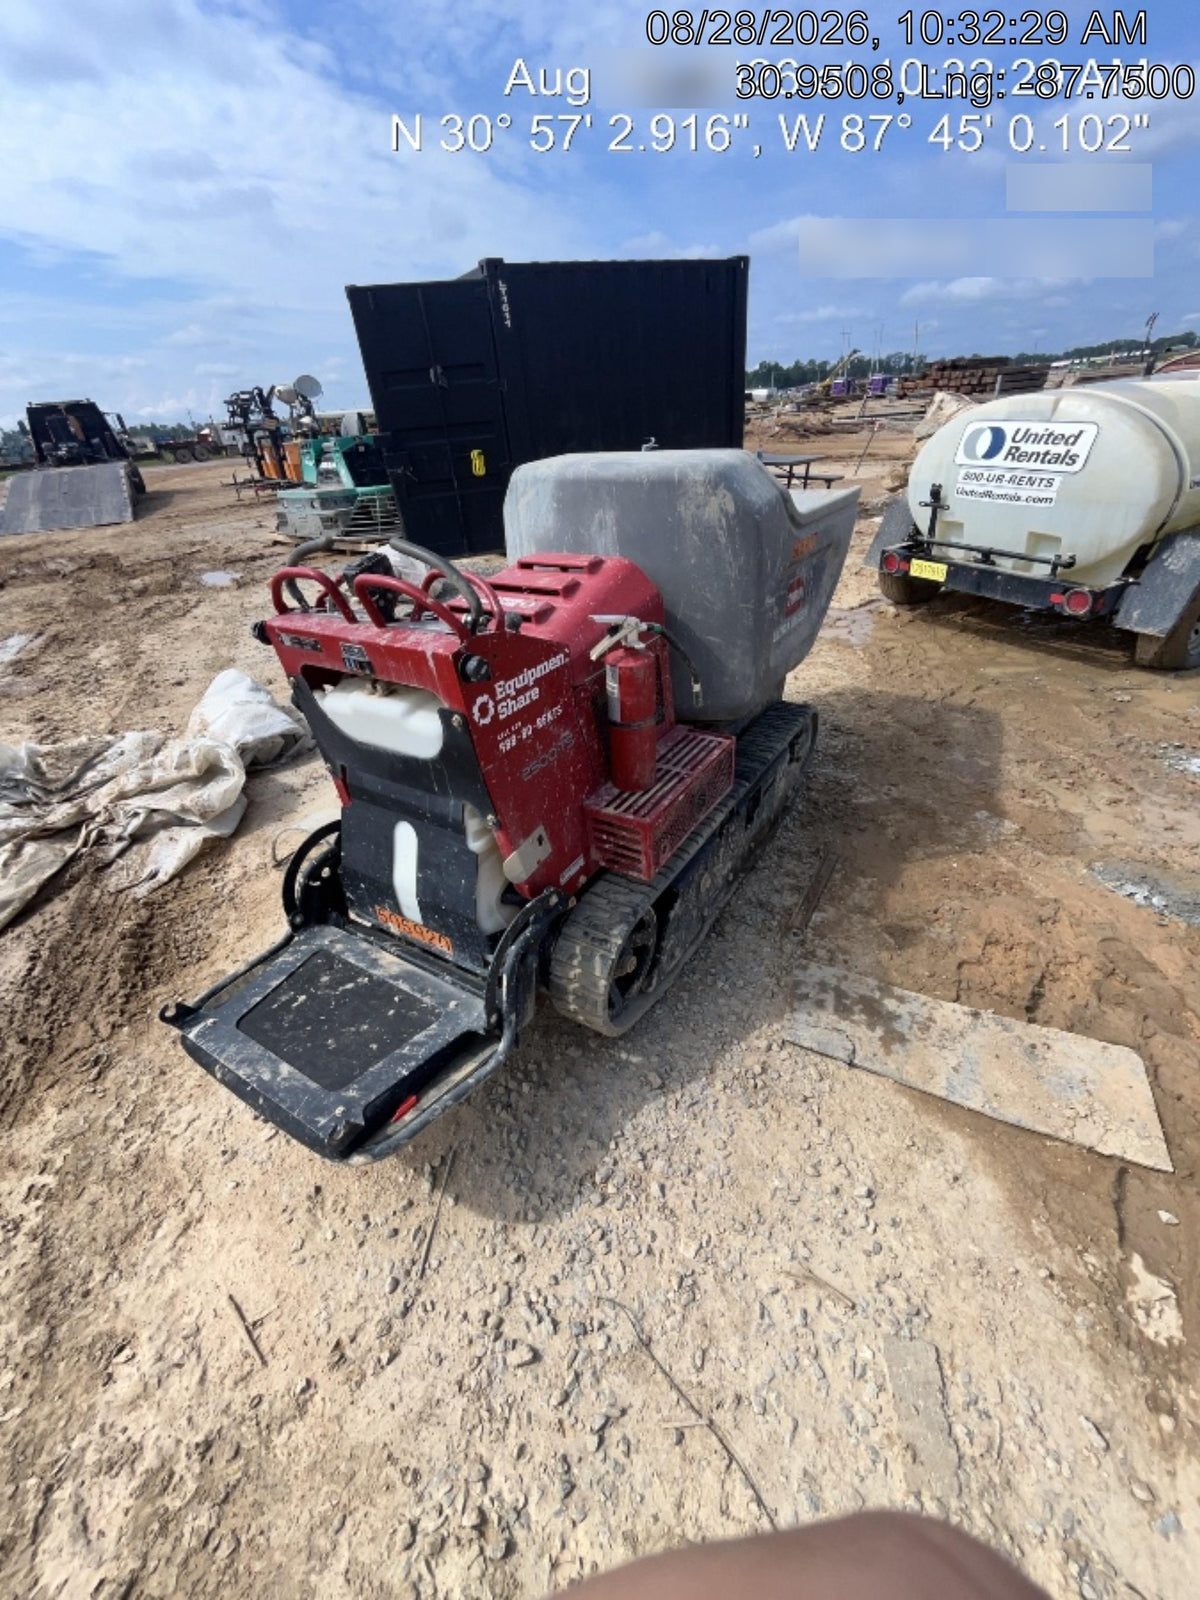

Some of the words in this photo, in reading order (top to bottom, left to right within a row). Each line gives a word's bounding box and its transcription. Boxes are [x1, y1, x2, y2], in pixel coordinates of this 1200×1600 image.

[1011, 427, 1084, 447] United
[1003, 445, 1081, 467] Rentals
[955, 486, 1054, 505] UnitedRentals.com
[497, 687, 540, 720] Share
